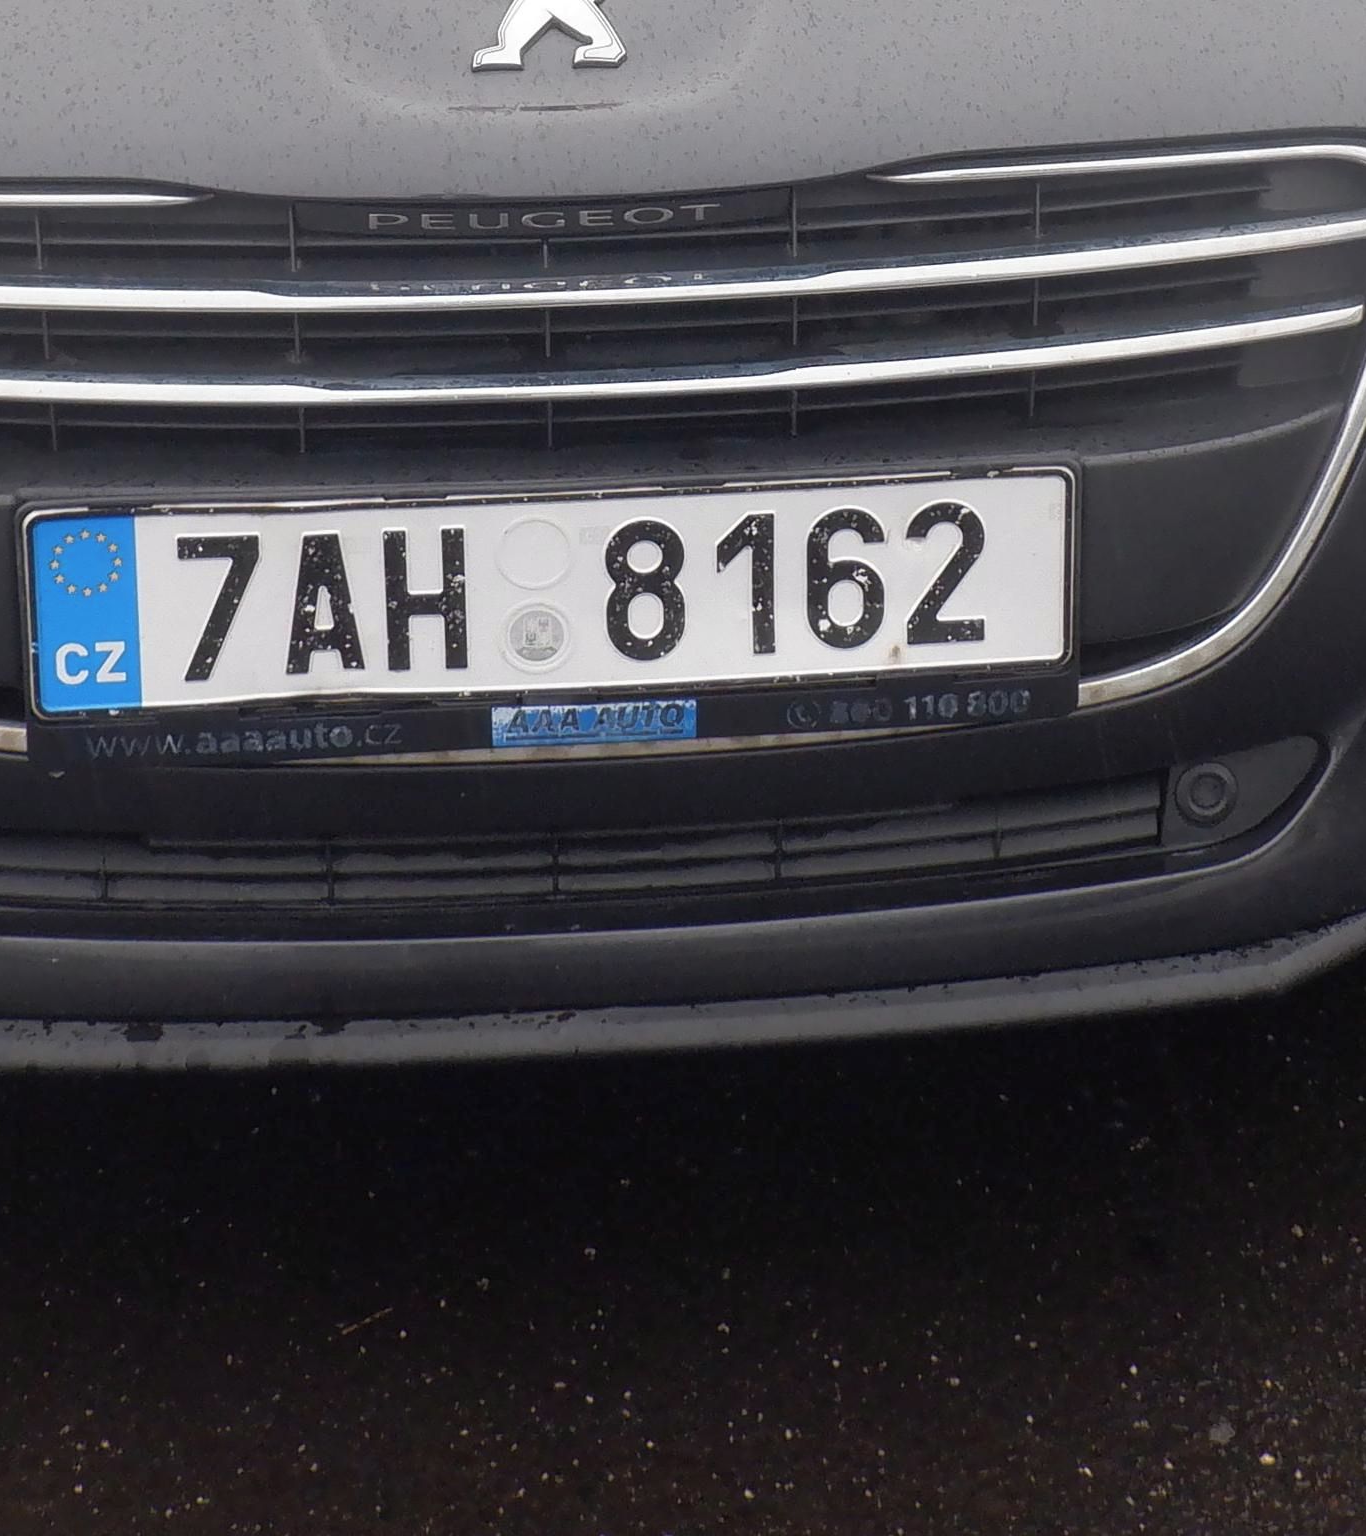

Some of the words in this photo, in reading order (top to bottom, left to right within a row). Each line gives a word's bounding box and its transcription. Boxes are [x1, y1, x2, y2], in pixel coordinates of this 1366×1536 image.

[368, 203, 721, 231] PEUGEOT
[176, 527, 469, 682] 7AH
[604, 501, 986, 661] 8162
[54, 640, 128, 686] CZ
[505, 706, 581, 734] AAA
[593, 700, 686, 731] AUTO
[904, 693, 959, 720] 110
[85, 721, 403, 759] www.aaaauto.cz
